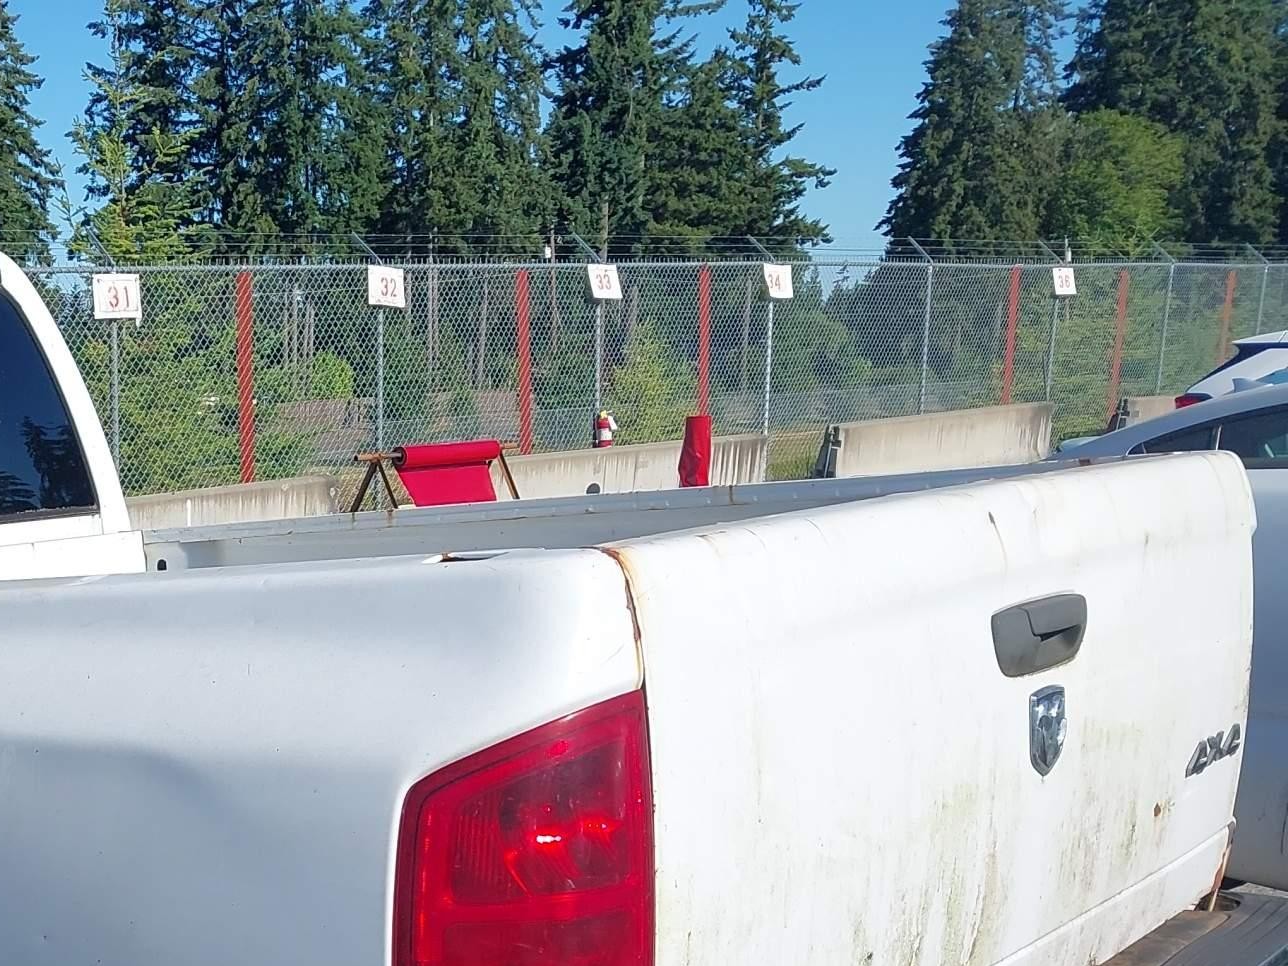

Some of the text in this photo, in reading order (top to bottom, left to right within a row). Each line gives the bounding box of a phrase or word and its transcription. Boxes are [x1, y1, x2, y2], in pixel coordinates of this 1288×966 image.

[381, 276, 397, 297] 32
[596, 273, 612, 290] 33
[768, 274, 781, 290] 34
[1058, 274, 1071, 289] 36
[108, 286, 129, 308] 31
